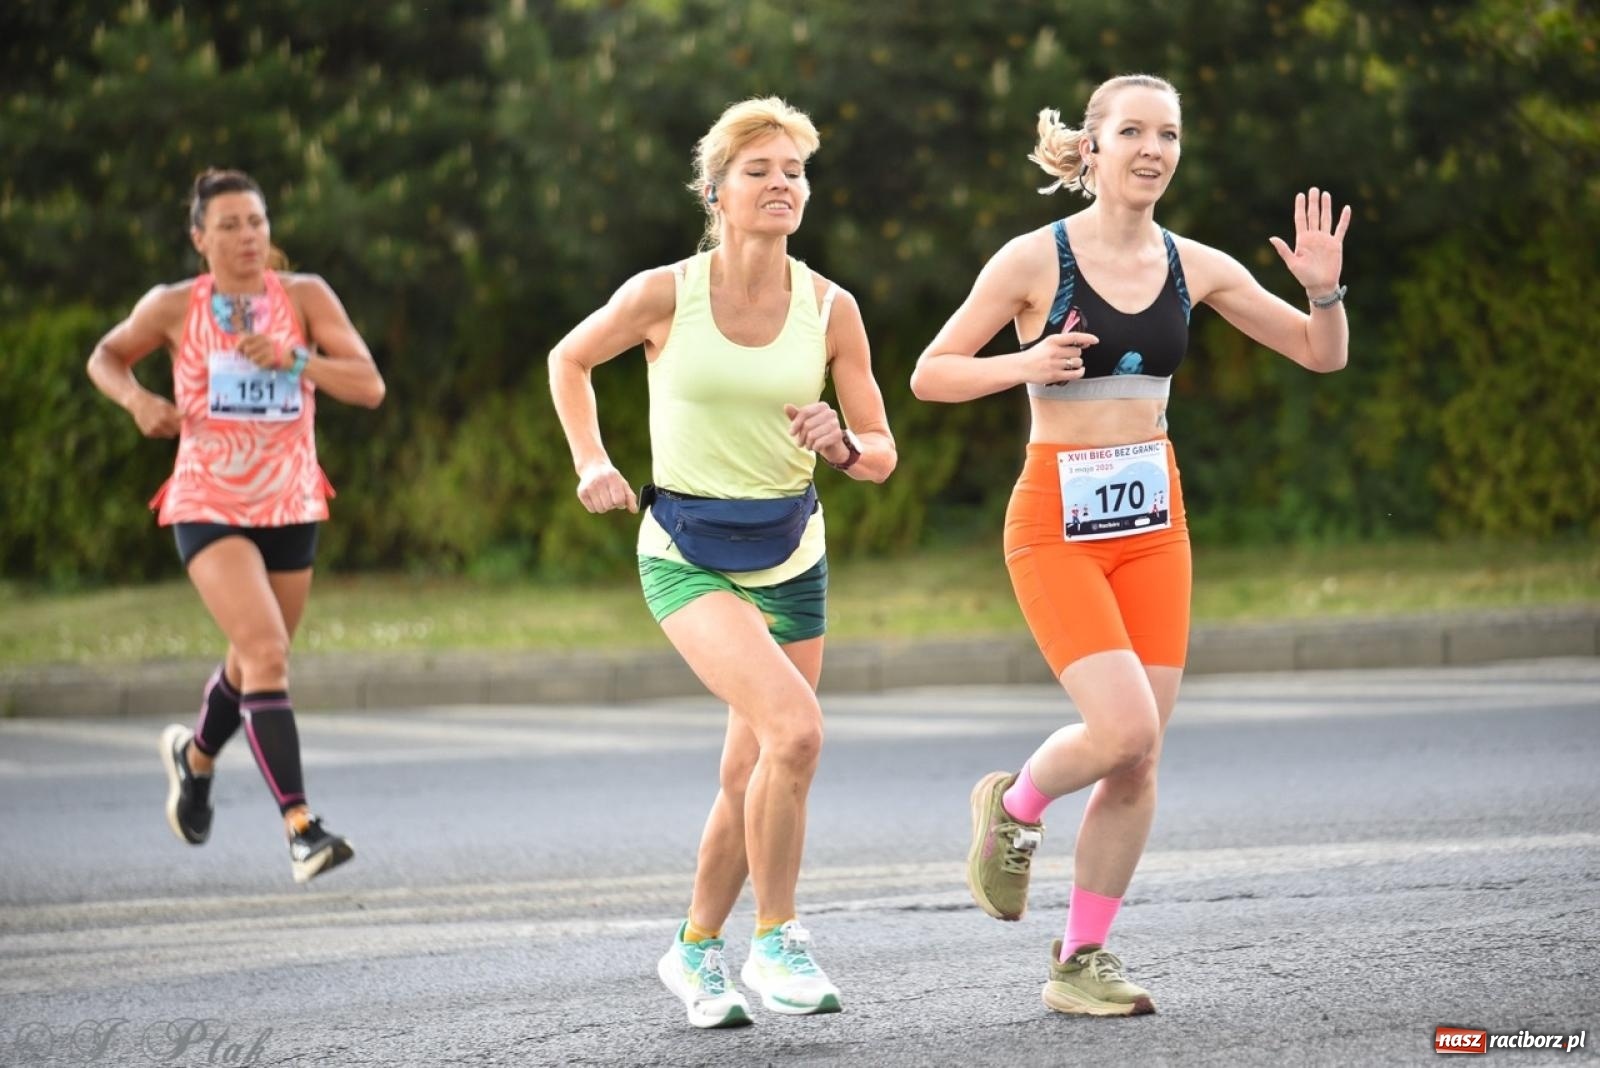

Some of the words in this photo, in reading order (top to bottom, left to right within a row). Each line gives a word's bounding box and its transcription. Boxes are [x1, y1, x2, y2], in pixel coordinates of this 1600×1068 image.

[237, 380, 275, 402] 151
[1068, 452, 1087, 462] XVII
[1089, 450, 1113, 460] BIEG
[1115, 447, 1131, 457] BEZ
[1132, 443, 1160, 455] GRANIC
[1095, 480, 1145, 513] 170
